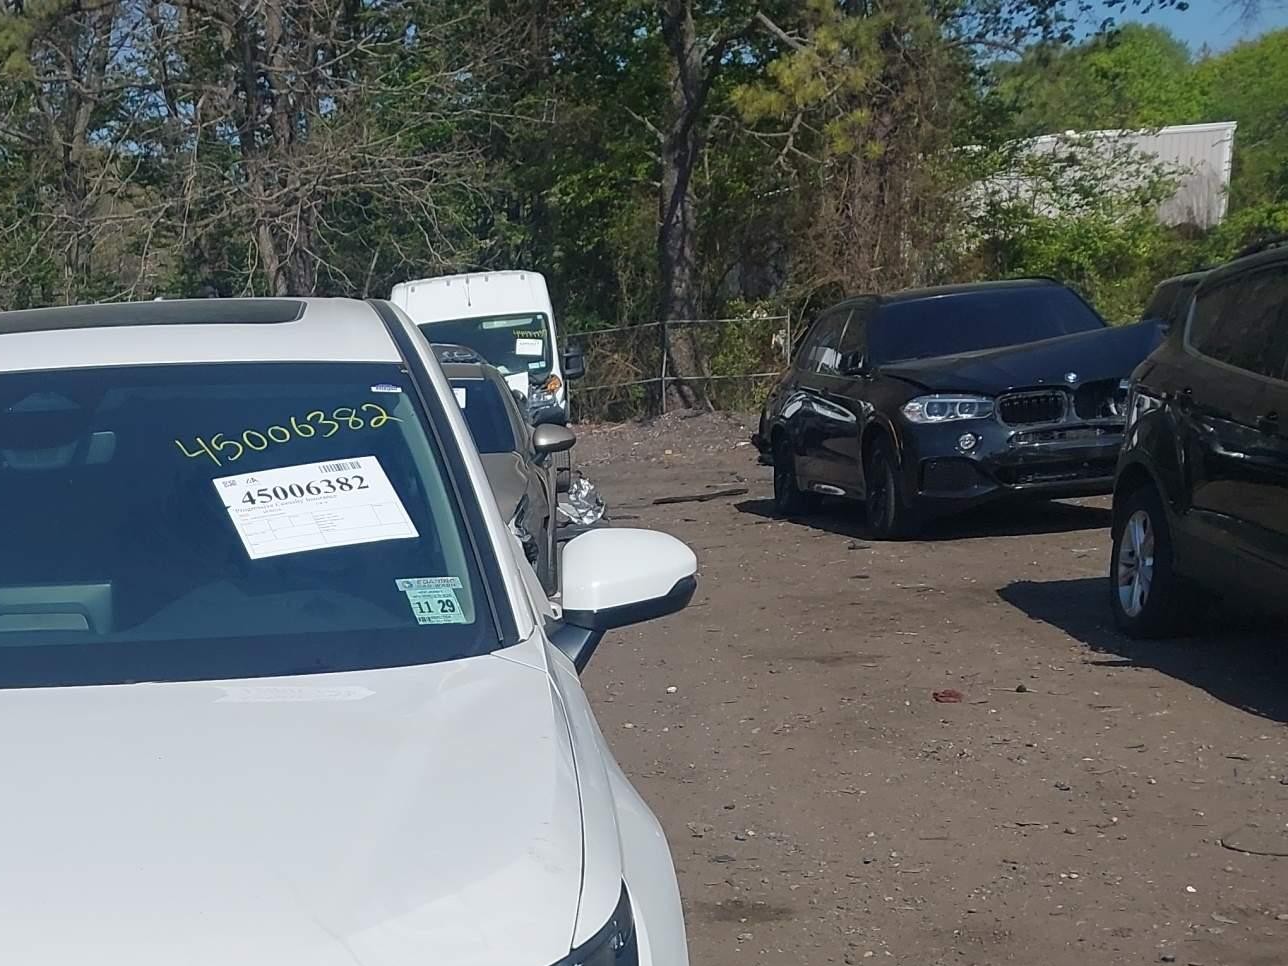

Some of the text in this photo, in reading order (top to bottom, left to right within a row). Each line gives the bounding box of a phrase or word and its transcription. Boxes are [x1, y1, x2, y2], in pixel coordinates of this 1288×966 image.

[175, 403, 405, 467] 45006382
[241, 474, 370, 506] 45006382
[416, 599, 455, 613] 11 29
